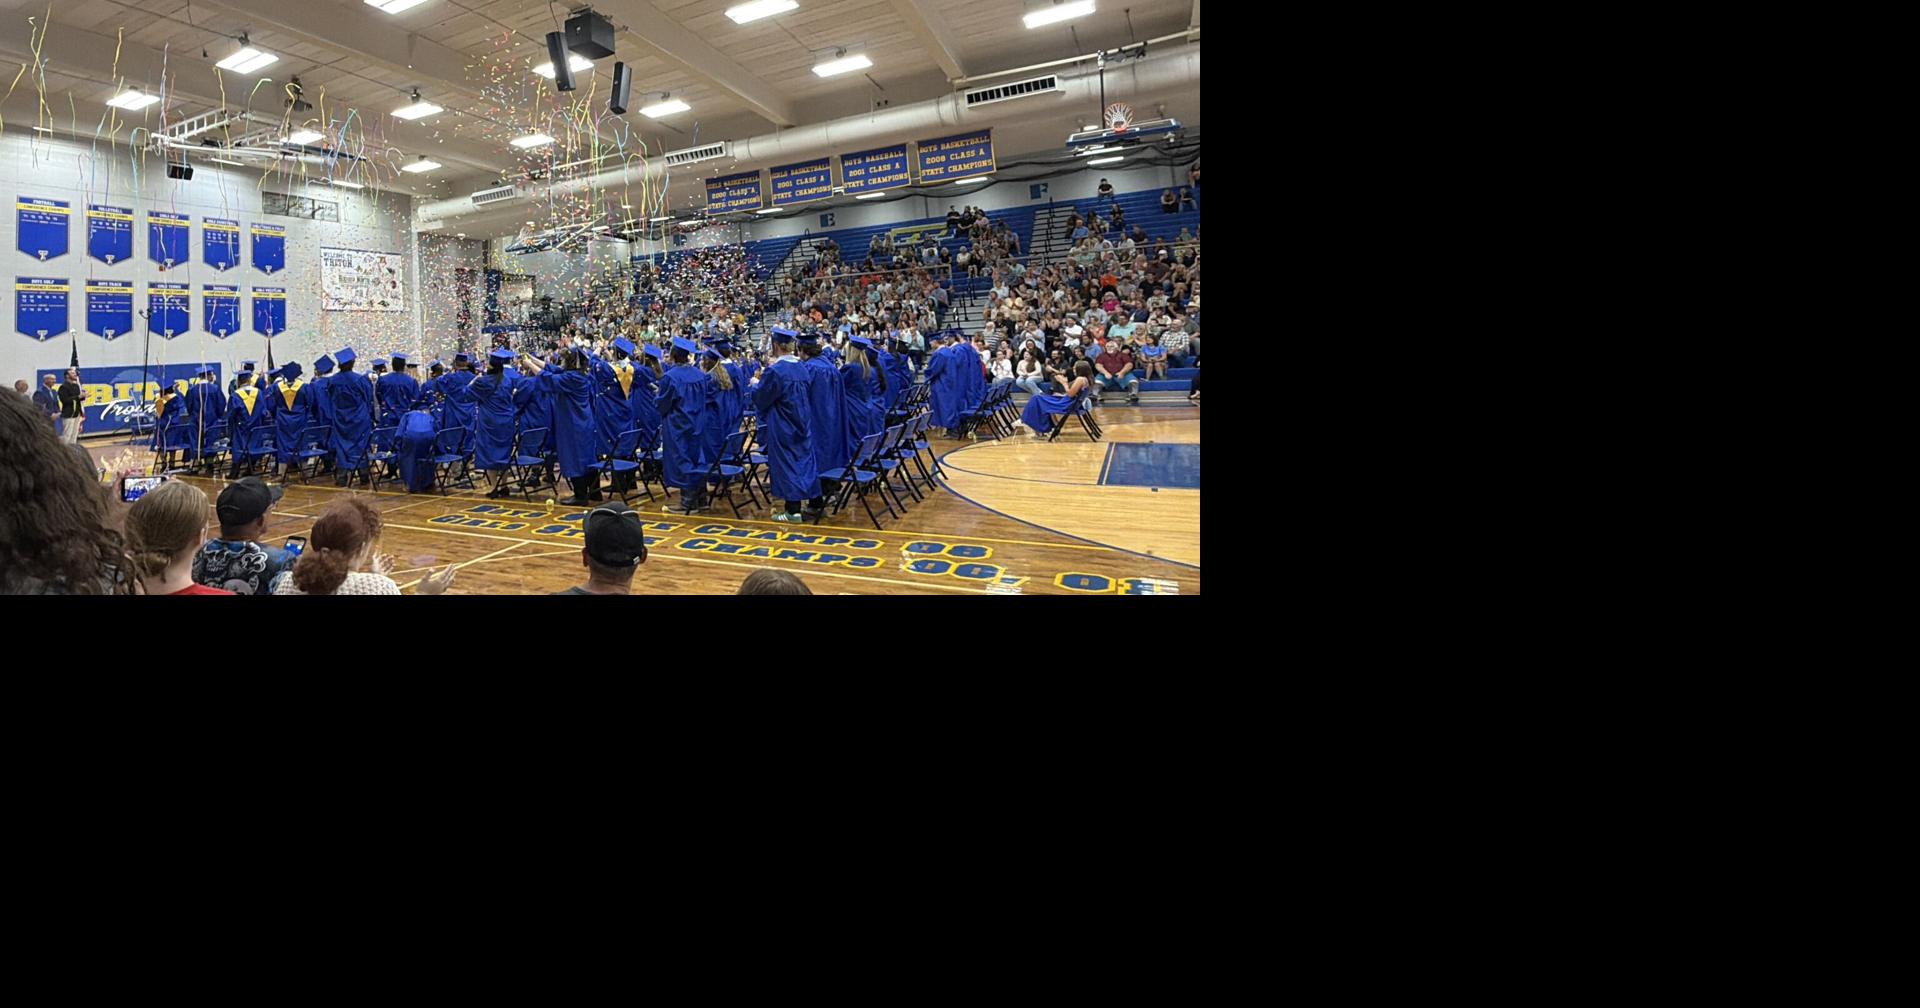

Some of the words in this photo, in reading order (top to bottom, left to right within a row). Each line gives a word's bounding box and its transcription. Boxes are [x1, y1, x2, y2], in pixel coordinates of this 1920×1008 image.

[920, 144, 938, 153] BOYS
[941, 136, 990, 150] BASKETBALL
[866, 151, 904, 163] BASEBALL
[950, 150, 976, 160] CLASS
[979, 148, 985, 156] A
[869, 164, 891, 173] CLASS
[921, 167, 945, 176] STATE
[948, 159, 993, 173] CHAMPIONS
[796, 176, 817, 186] CLASS
[844, 180, 865, 188] STATE
[868, 173, 908, 185] CHAMPIONS
[729, 188, 748, 197] CLASS
[773, 191, 792, 200] STATE
[795, 185, 831, 197] CHAMPIONS
[689, 523, 885, 550] CHAMPS
[674, 537, 886, 569] CHAMPS
